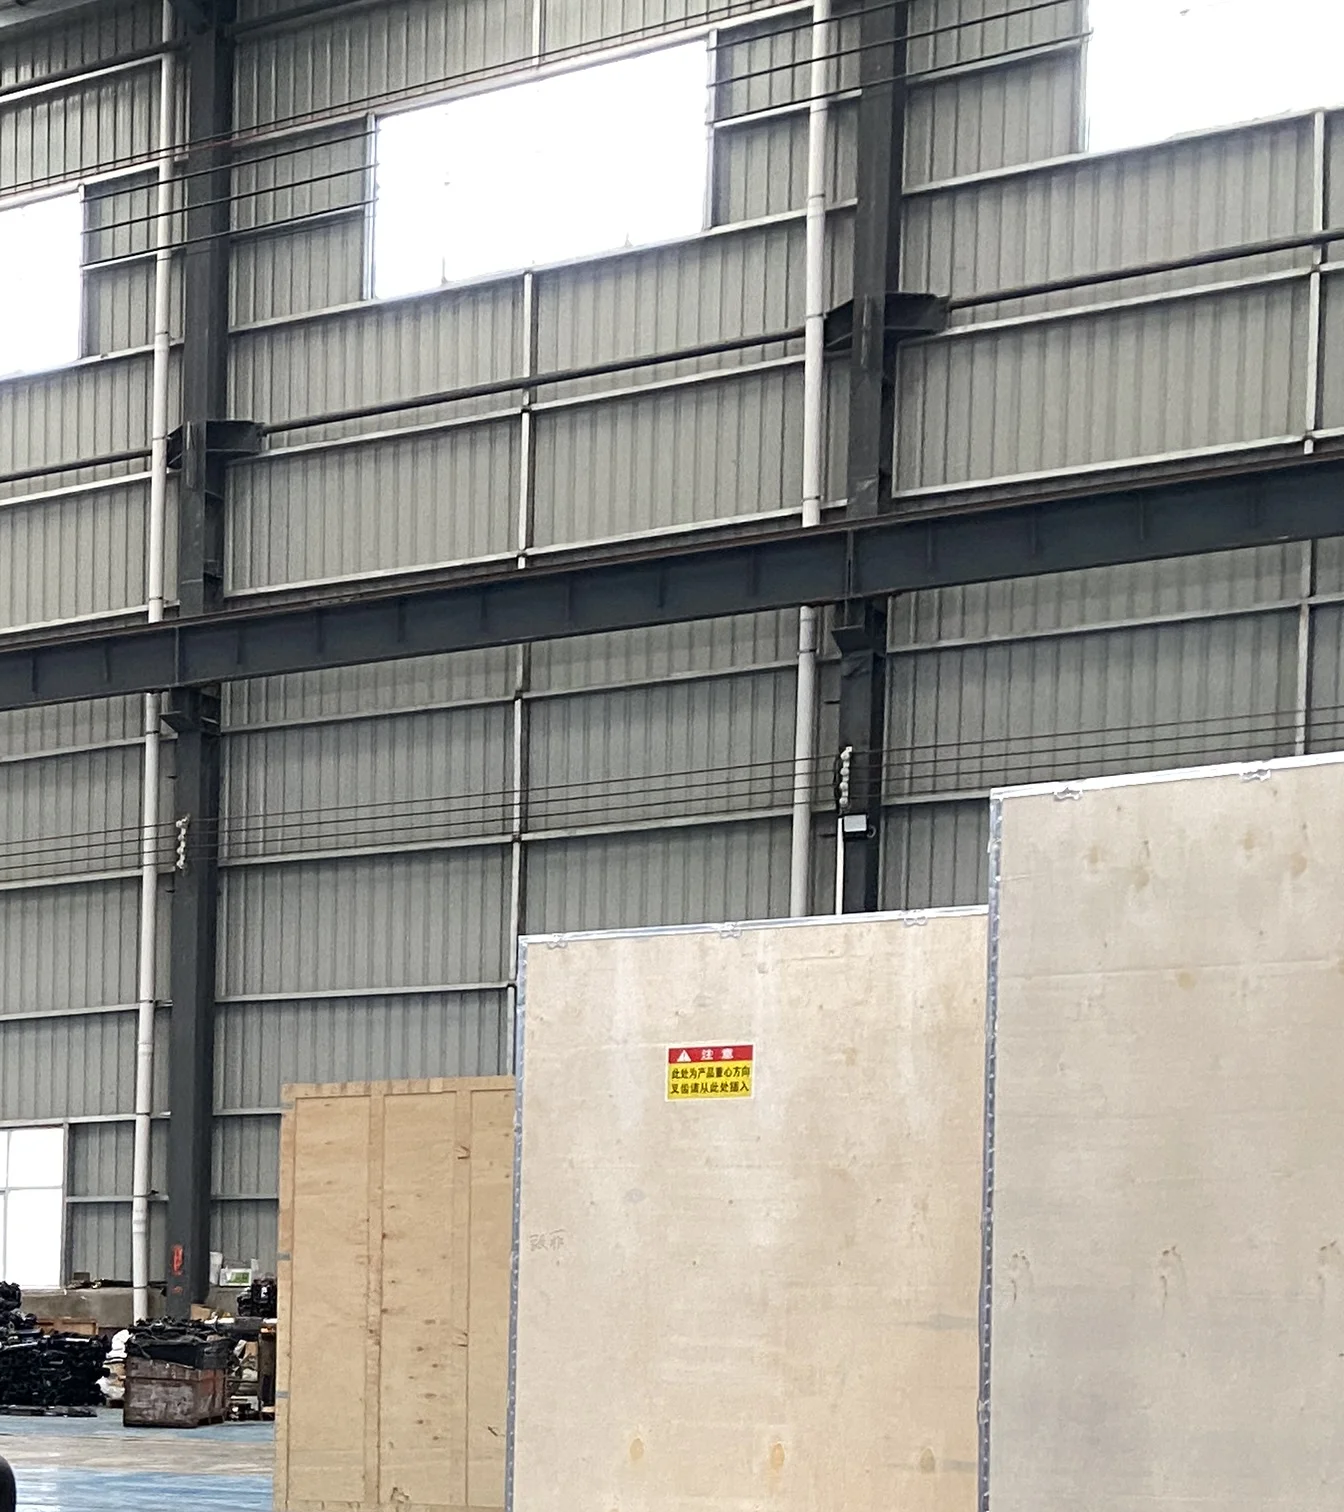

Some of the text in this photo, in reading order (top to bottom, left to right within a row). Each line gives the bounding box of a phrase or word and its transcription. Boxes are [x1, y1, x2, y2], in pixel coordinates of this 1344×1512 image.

[701, 1048, 733, 1060] 注意
[672, 1066, 750, 1079] 此处为产品重心方向
